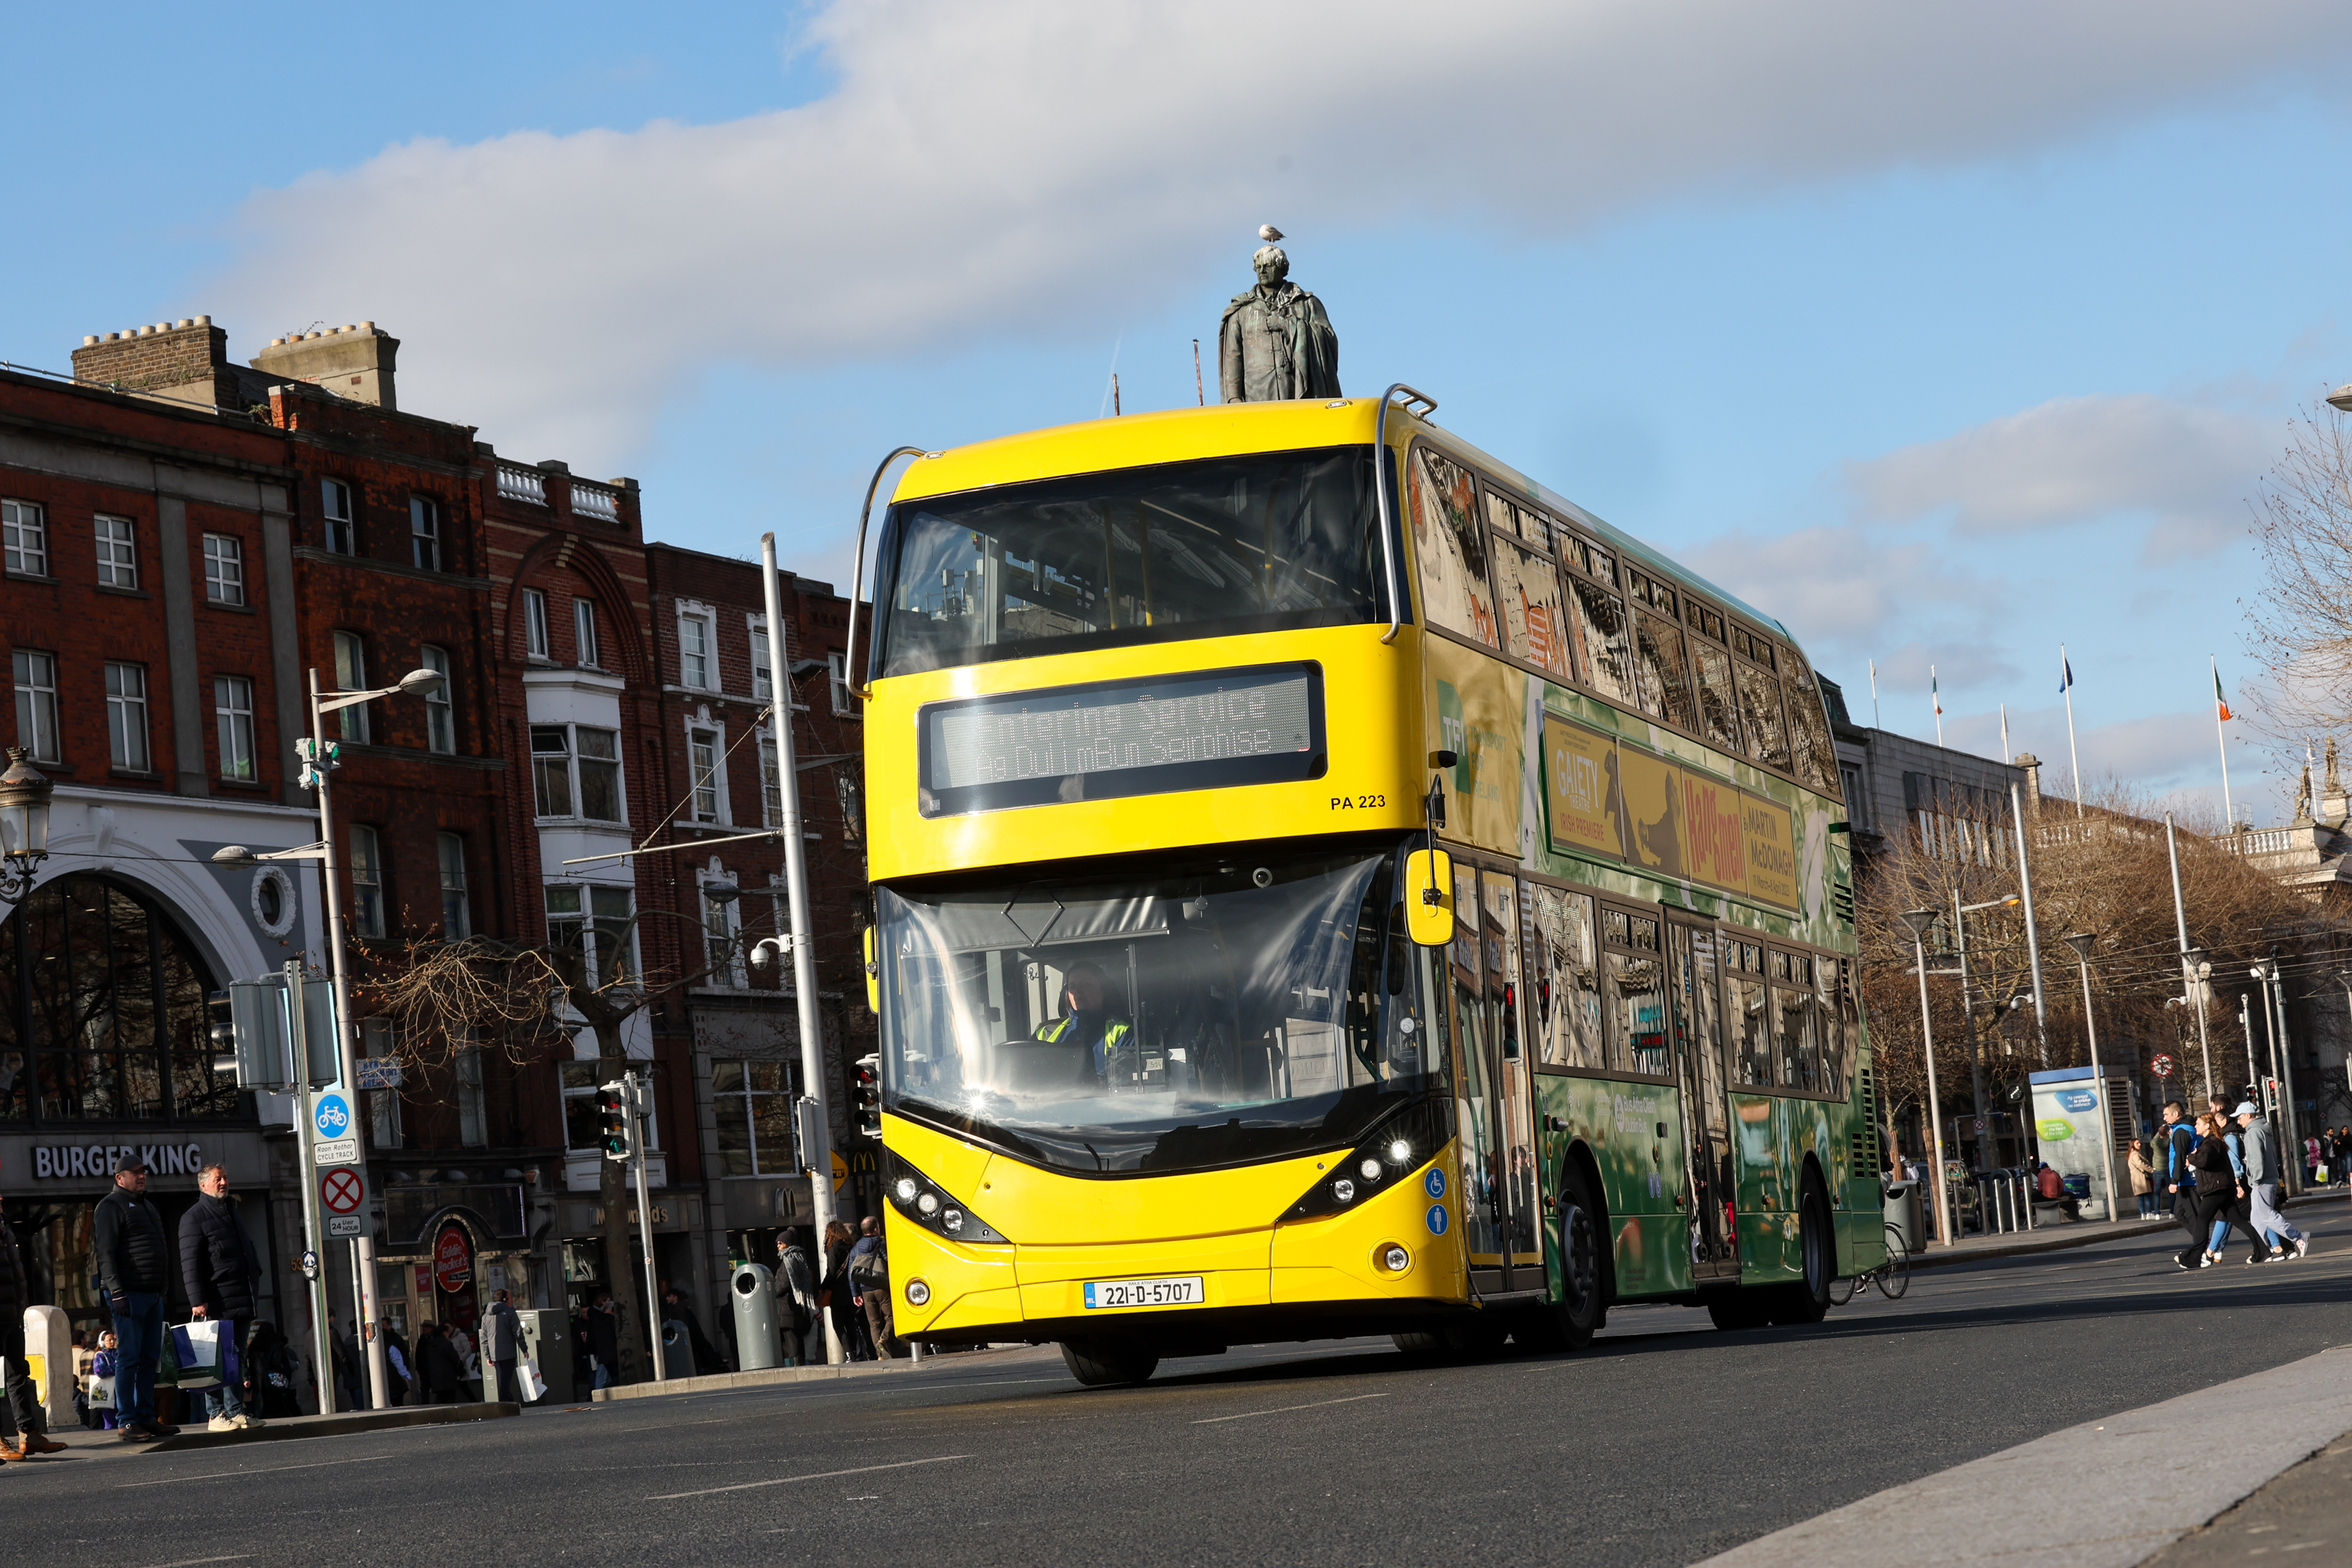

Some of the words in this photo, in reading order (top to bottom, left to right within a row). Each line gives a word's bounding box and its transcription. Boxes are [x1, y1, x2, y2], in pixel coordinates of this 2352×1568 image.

[977, 702, 1121, 746] Entering
[1138, 686, 1267, 729] Service
[1443, 716, 1465, 756] TFI
[1469, 725, 1507, 753] TRANSPORT
[1015, 742, 1054, 777] Dul
[1471, 753, 1485, 772] FOR
[1474, 779, 1501, 803] IRELAND
[1556, 749, 1599, 808] GAIETY
[1330, 797, 1354, 811] PA
[1358, 794, 1386, 808] 223
[1570, 794, 1591, 813] THEATRE
[1560, 812, 1576, 833] IRISH
[1576, 817, 1605, 842] PREMIERE
[1748, 806, 1777, 842] MARTIN
[1751, 839, 1794, 878] McDONAGH
[1623, 1094, 1632, 1112] Bus
[1625, 1117, 1639, 1133] Dublin
[1639, 1118, 1647, 1133] Bus
[141, 1143, 201, 1174] KING
[437, 1254, 468, 1273] Rocket's
[441, 1243, 463, 1259] Eddie
[1105, 1283, 1192, 1305] 221-D-5707
